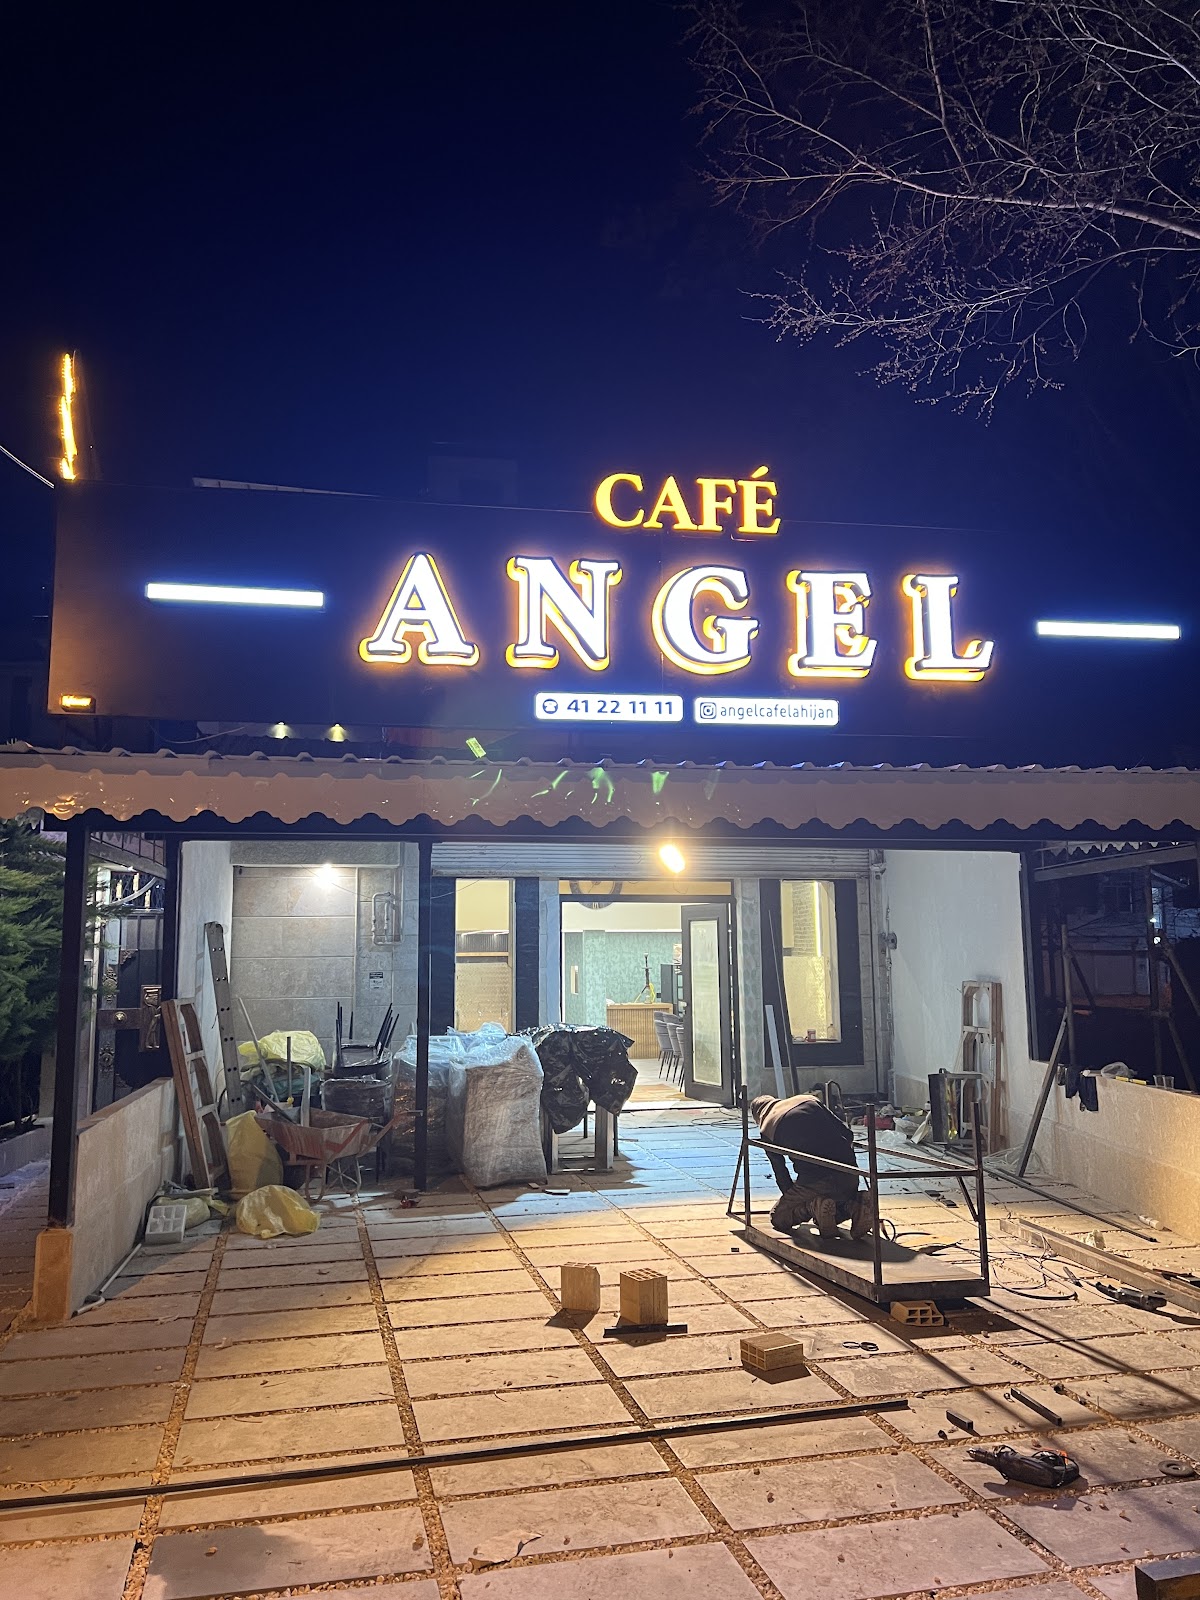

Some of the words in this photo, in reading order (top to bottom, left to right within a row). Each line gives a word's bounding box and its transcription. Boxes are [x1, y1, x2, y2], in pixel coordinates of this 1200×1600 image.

[594, 465, 781, 534] CAFÉ
[358, 551, 994, 682] ANGEL
[566, 699, 590, 713] 41
[597, 699, 621, 714] 22
[628, 700, 647, 715] 11
[654, 701, 673, 715] 11
[720, 703, 833, 721] angelcafelahijan
